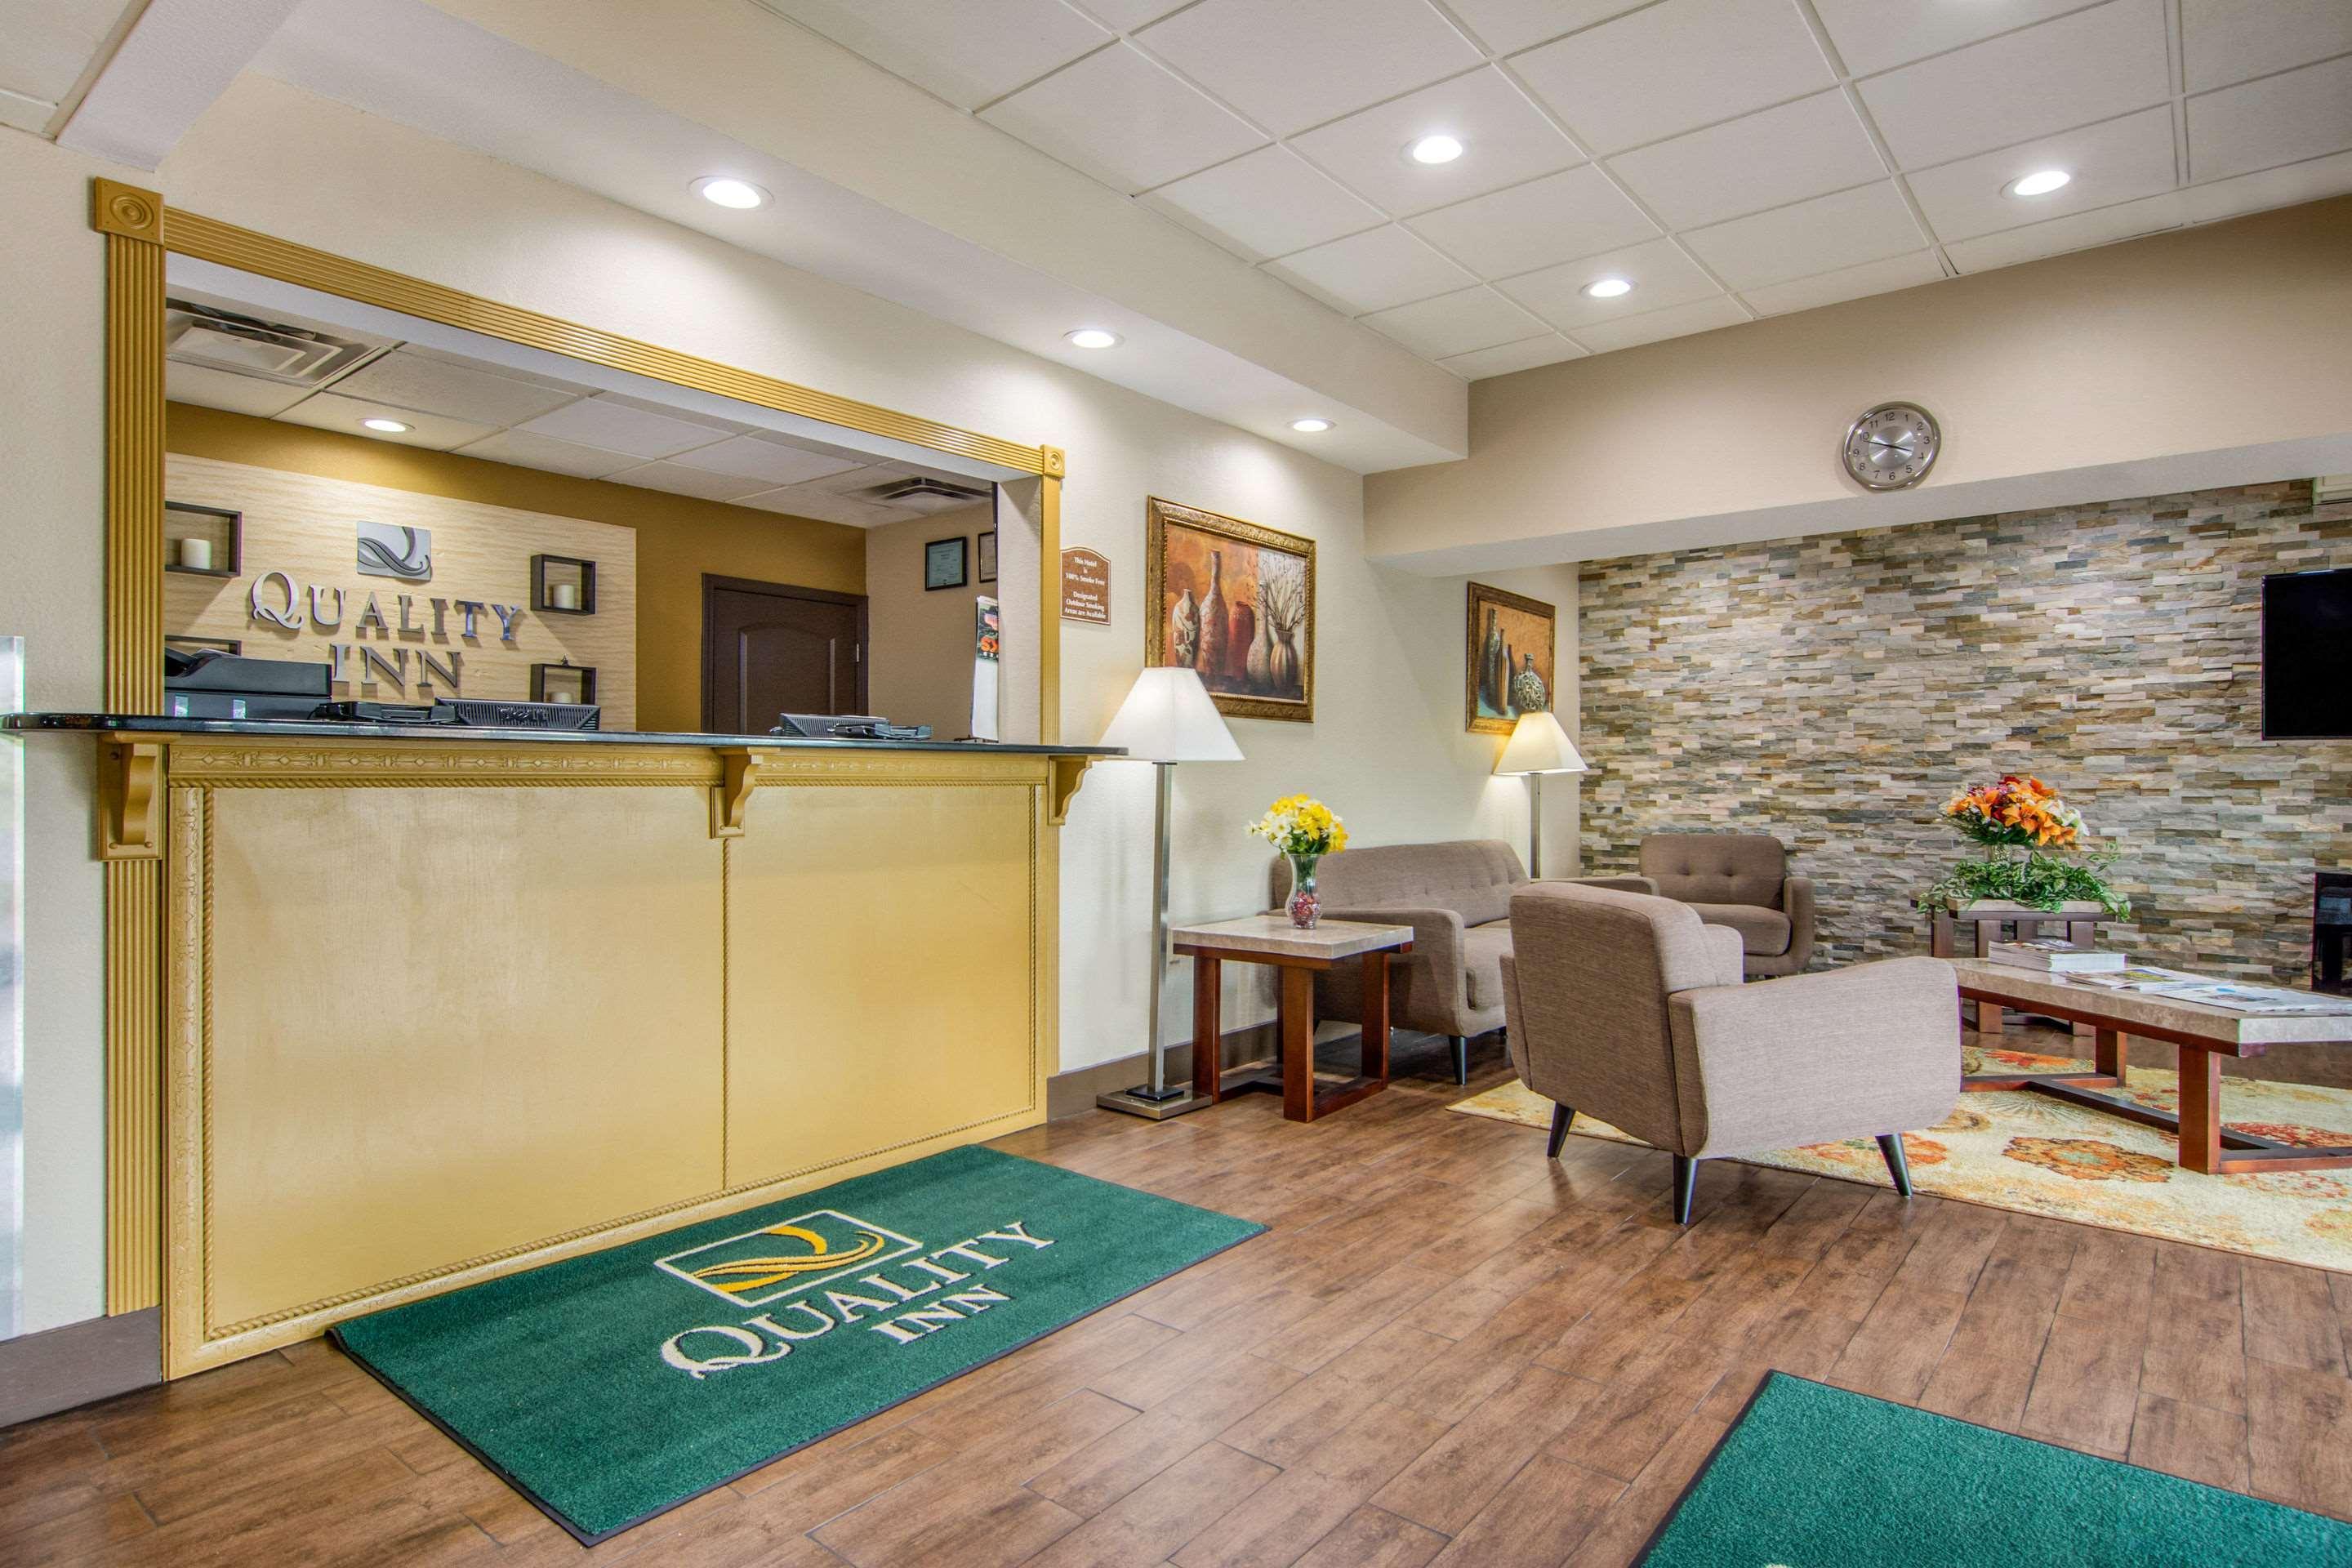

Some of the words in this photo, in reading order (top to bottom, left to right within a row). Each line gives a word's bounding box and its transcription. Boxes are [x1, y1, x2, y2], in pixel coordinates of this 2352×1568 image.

[1885, 412, 1895, 421] 12
[1869, 421, 1878, 429] 11
[1917, 422, 1923, 430] 2
[1860, 432, 1869, 440] 10
[1923, 436, 1930, 444] 3
[1853, 448, 1860, 457] 9
[1860, 462, 1865, 470] 8
[1906, 465, 1913, 473] 5
[1873, 470, 1880, 479] 7
[1889, 472, 1895, 480] 6
[252, 571, 522, 641] QUALITY
[332, 644, 461, 688] INN
[661, 1222, 1055, 1379] QUALITY
[870, 1284, 1011, 1344] INN
